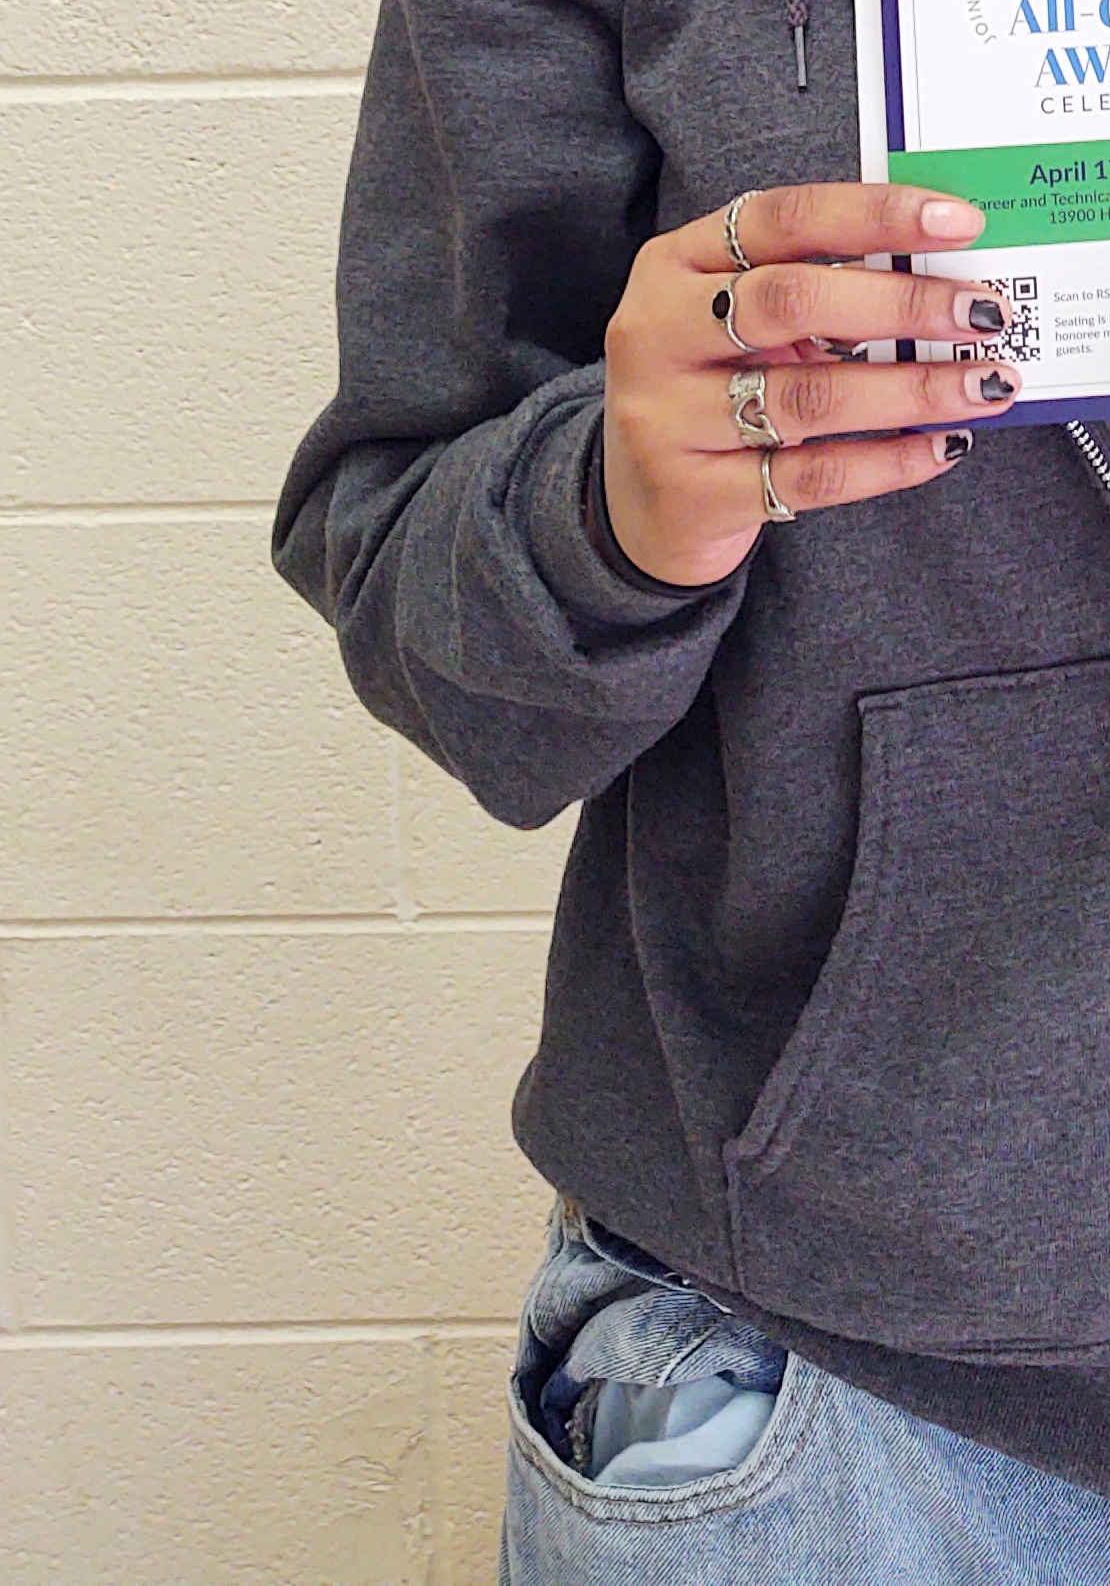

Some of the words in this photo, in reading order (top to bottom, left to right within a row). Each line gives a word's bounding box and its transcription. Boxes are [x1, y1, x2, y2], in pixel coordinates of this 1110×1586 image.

[967, 0, 997, 45] JOIN
[1029, 161, 1087, 188] April
[1020, 193, 1047, 209] and
[1049, 208, 1096, 225] 13900
[1053, 291, 1079, 303] Scan
[1082, 291, 1094, 301] to
[1054, 314, 1095, 328] Seating
[1098, 314, 1106, 325] is
[1055, 330, 1100, 342] honoree
[1055, 343, 1094, 358] guests.
